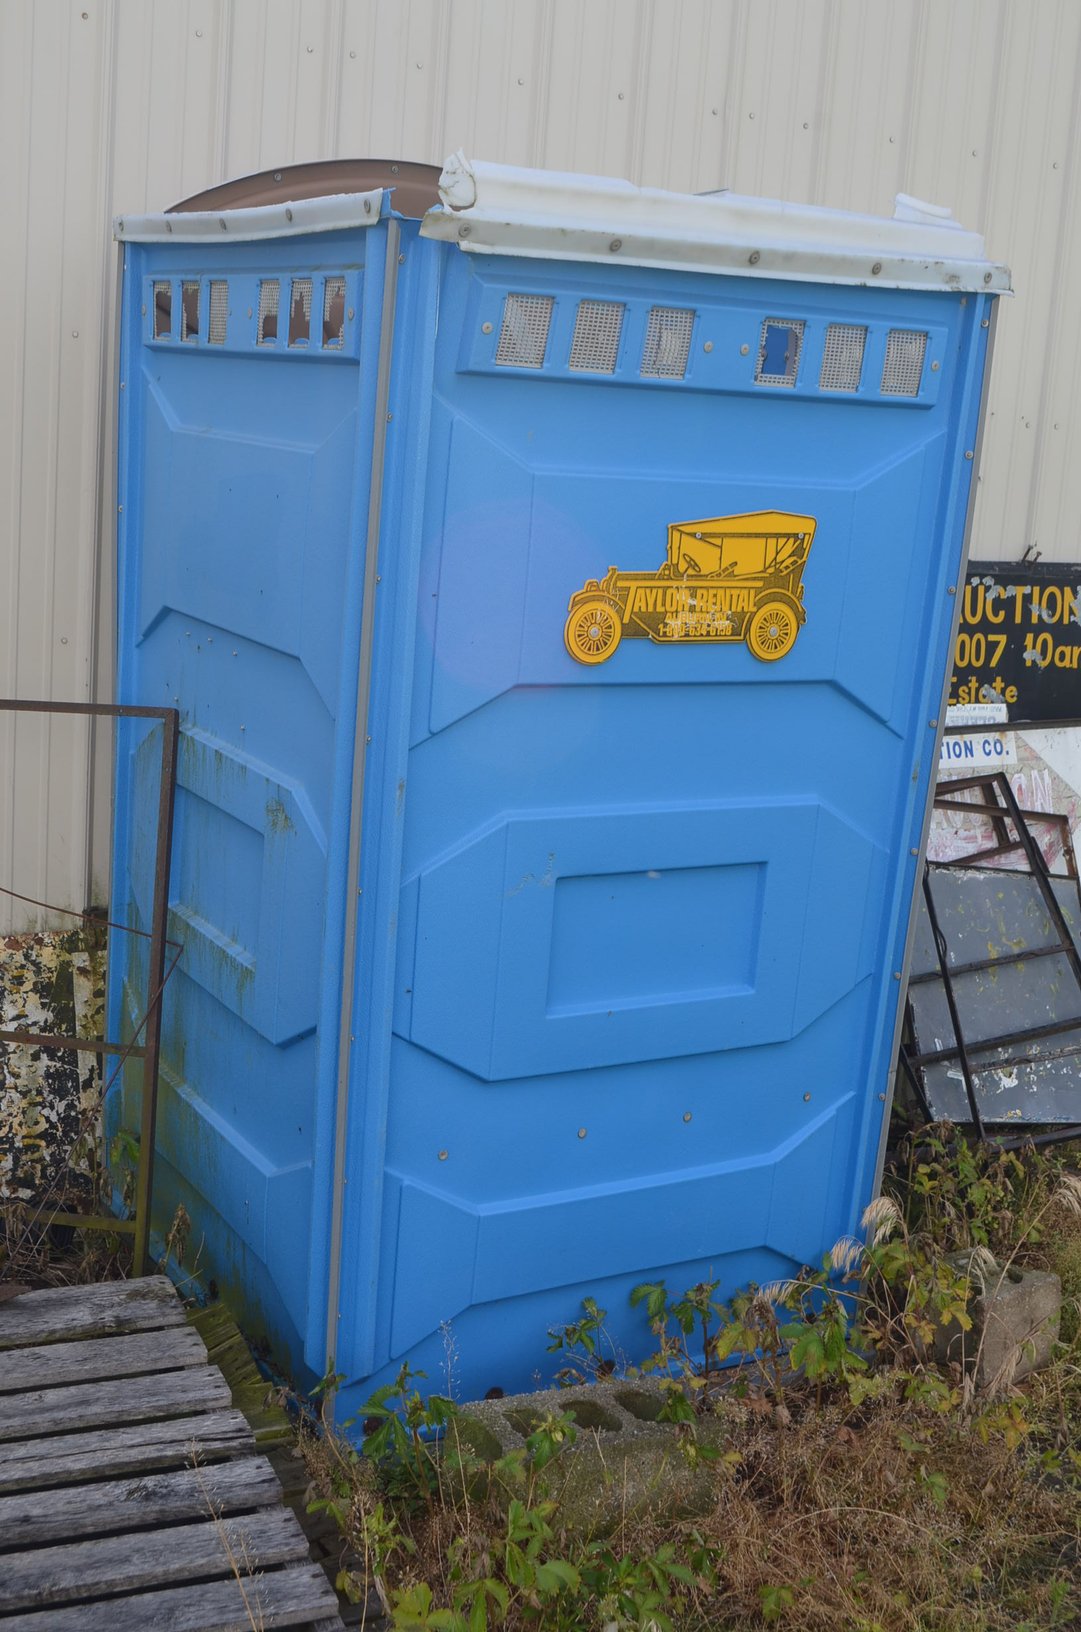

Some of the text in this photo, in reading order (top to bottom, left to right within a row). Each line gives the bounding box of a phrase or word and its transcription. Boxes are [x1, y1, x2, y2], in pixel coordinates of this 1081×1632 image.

[619, 581, 757, 623] TAYLOR RENTAL
[960, 584, 1081, 625] UCTION
[982, 738, 1010, 757] CO.
